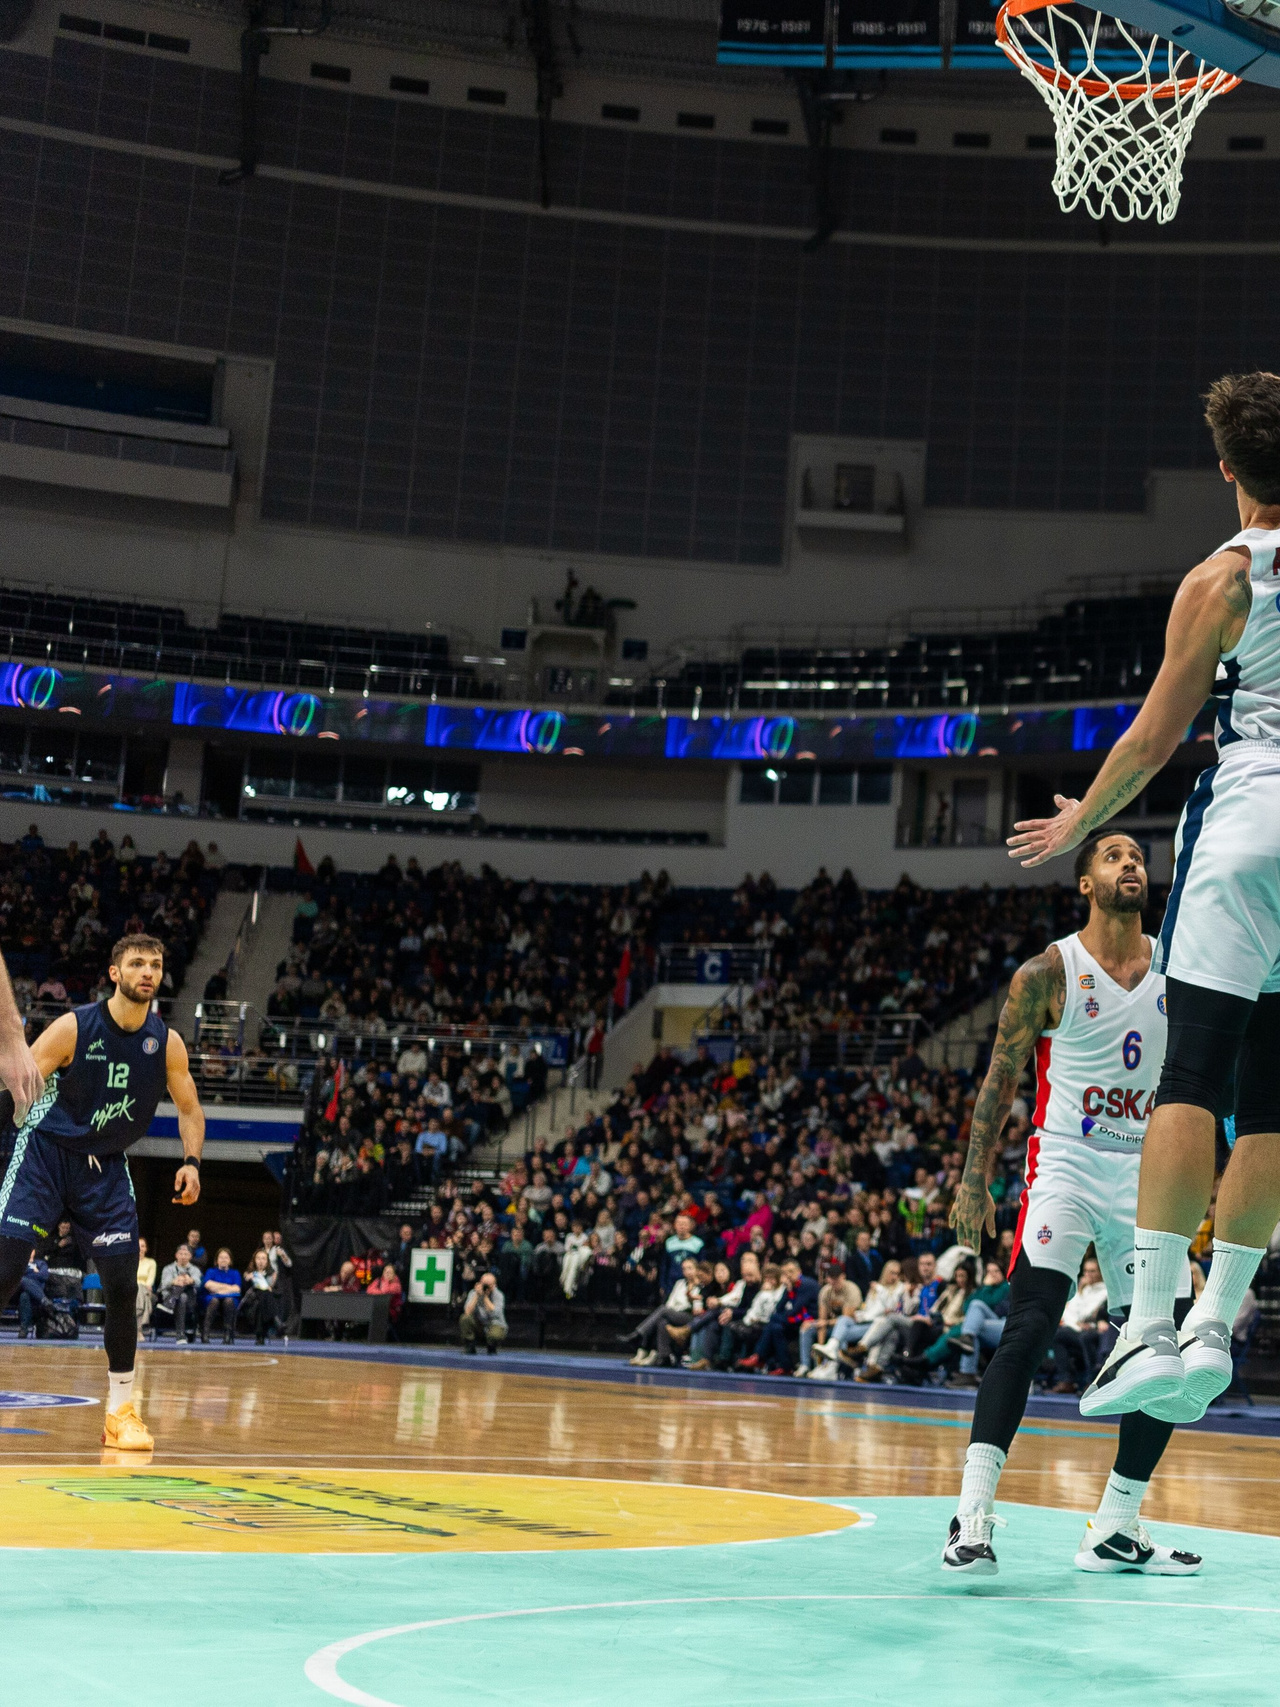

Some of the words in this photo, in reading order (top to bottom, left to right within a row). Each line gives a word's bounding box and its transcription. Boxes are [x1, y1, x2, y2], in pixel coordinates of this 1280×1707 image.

[1122, 1030, 1142, 1071] 6
[106, 1062, 130, 1089] 12
[1083, 1086, 1156, 1121] CSKA
[1140, 1259, 1147, 1269] 8
